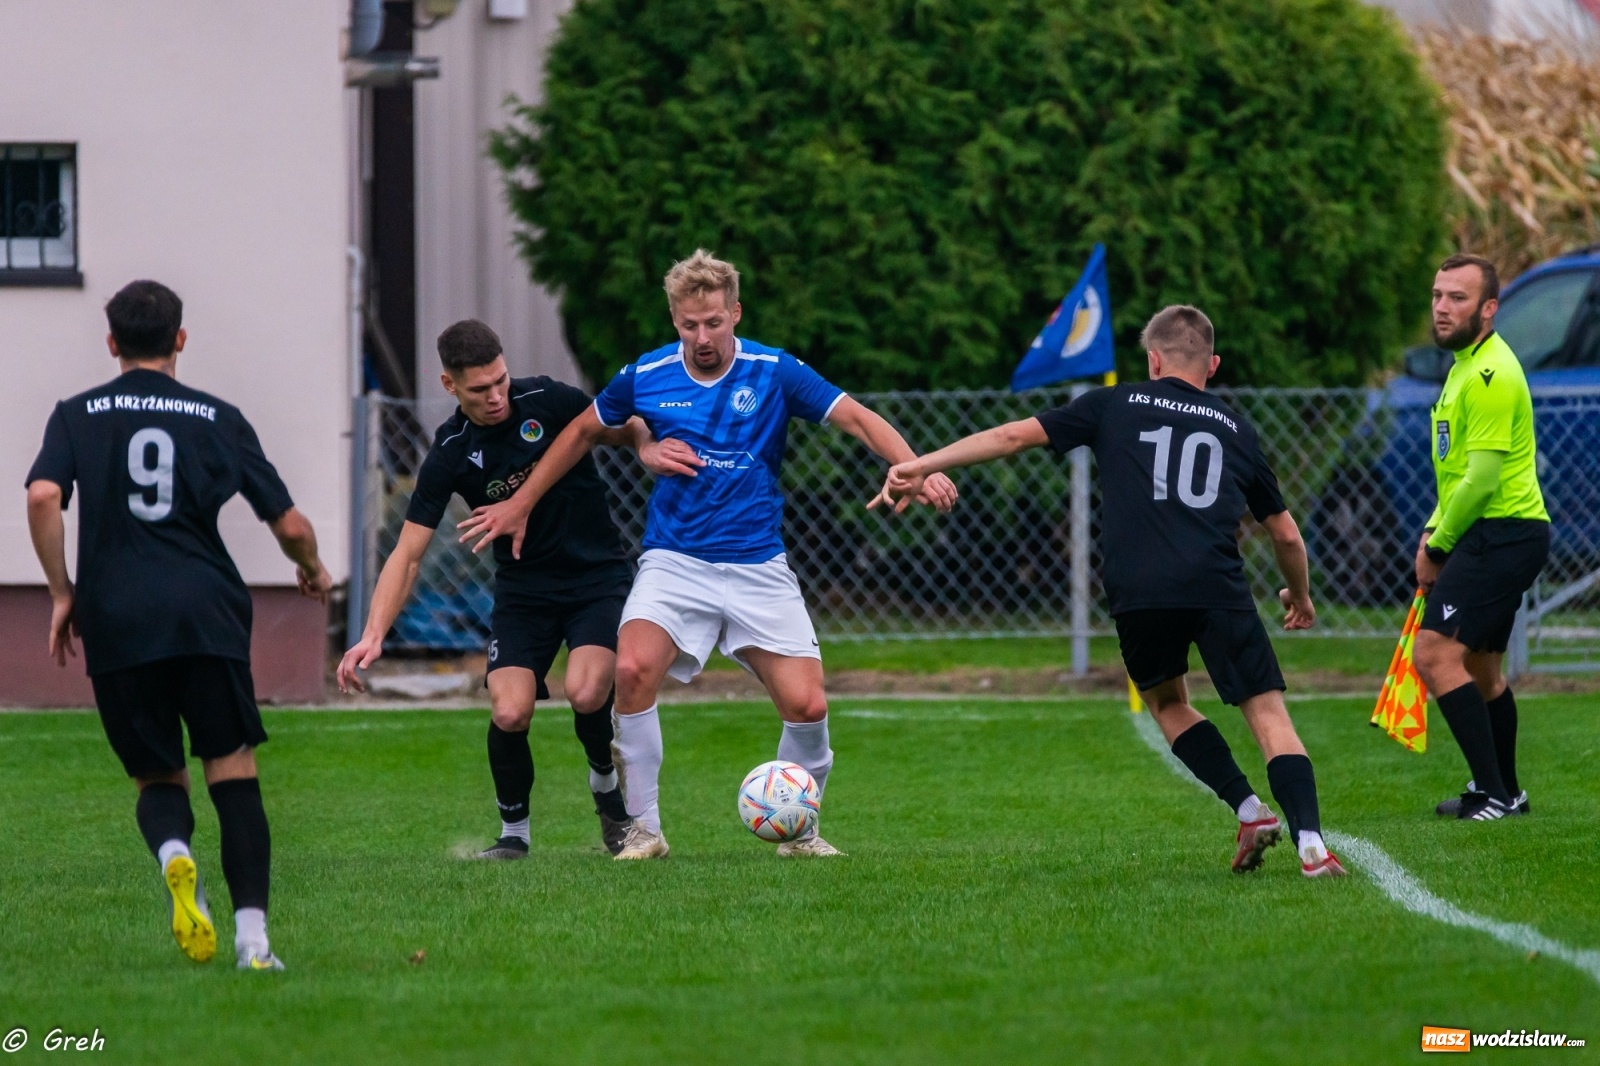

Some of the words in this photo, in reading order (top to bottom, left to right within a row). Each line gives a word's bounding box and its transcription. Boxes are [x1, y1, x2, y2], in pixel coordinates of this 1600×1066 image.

[86, 396, 112, 413] LKS
[1128, 393, 1151, 404] LKS
[127, 427, 175, 522] 9
[1139, 425, 1223, 509] 10
